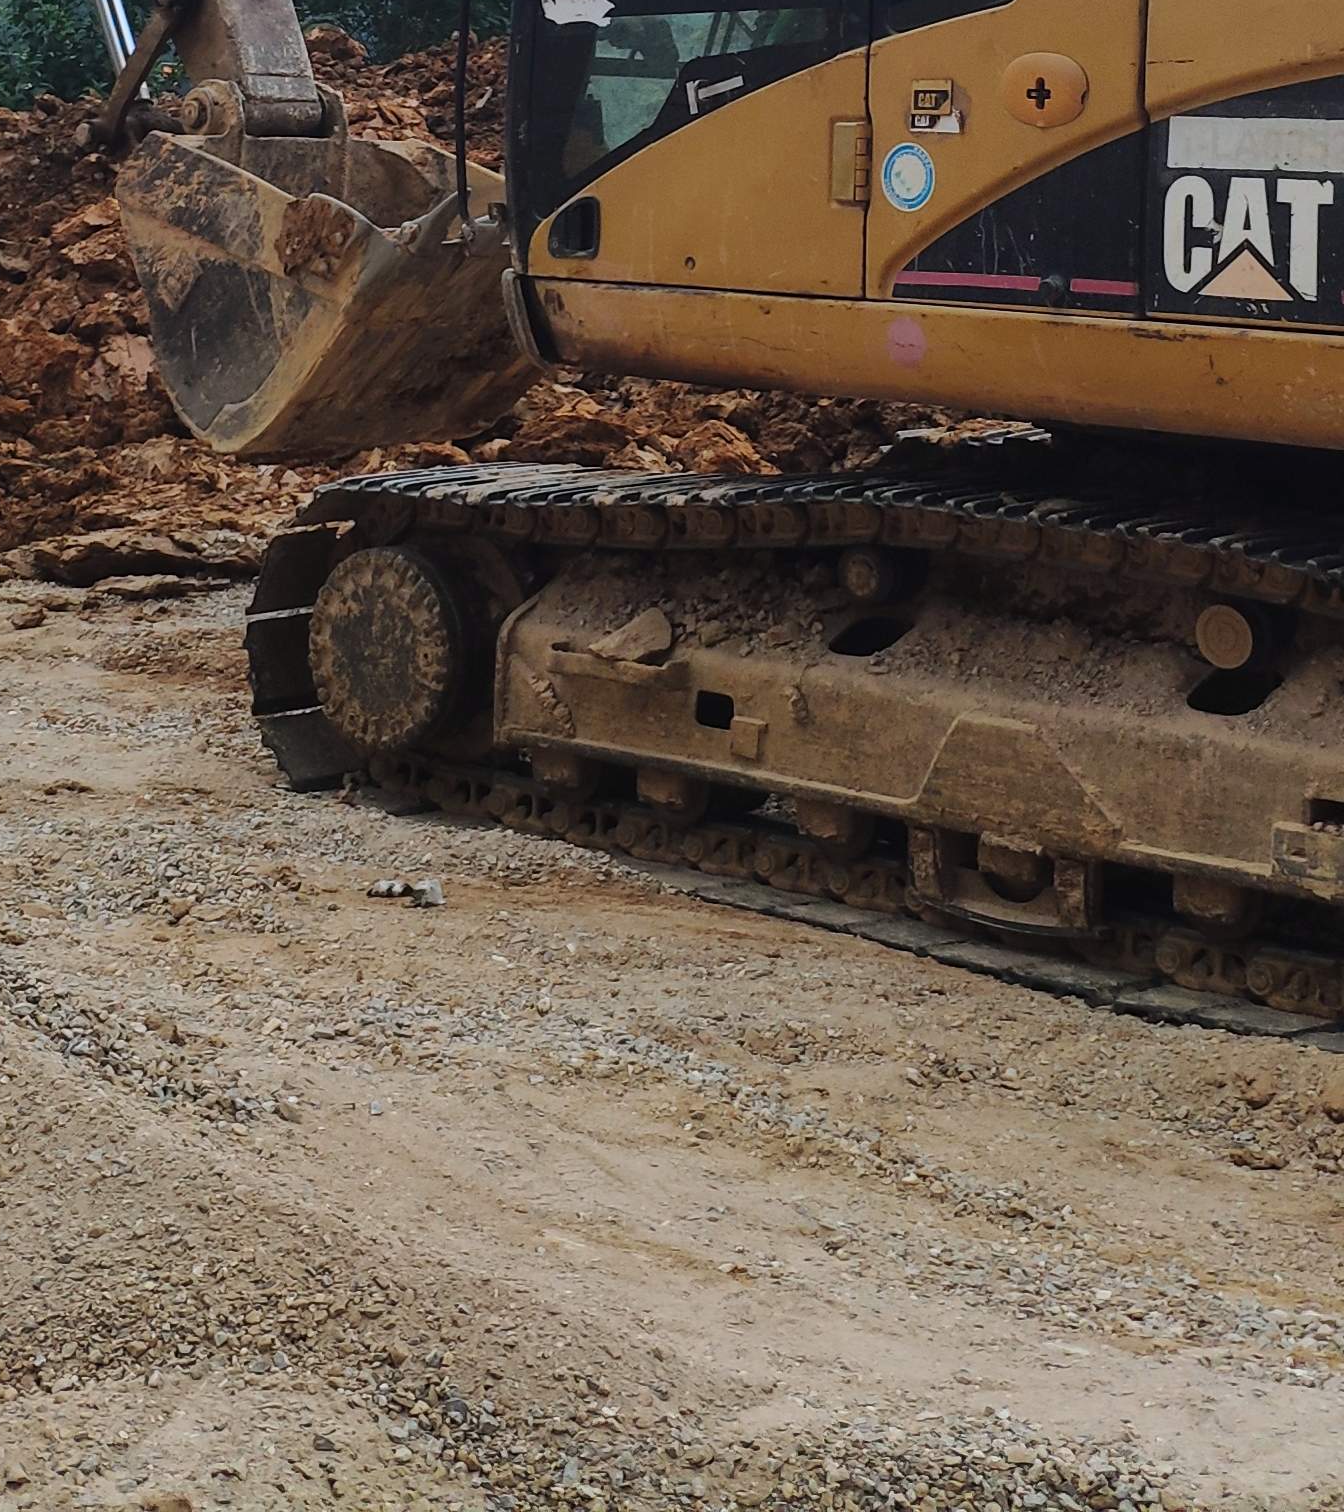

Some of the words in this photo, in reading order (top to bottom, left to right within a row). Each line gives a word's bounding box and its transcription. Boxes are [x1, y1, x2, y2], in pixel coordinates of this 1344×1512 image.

[917, 92, 937, 108] CAT
[914, 115, 930, 127] CAT
[1163, 175, 1335, 301] CAT
